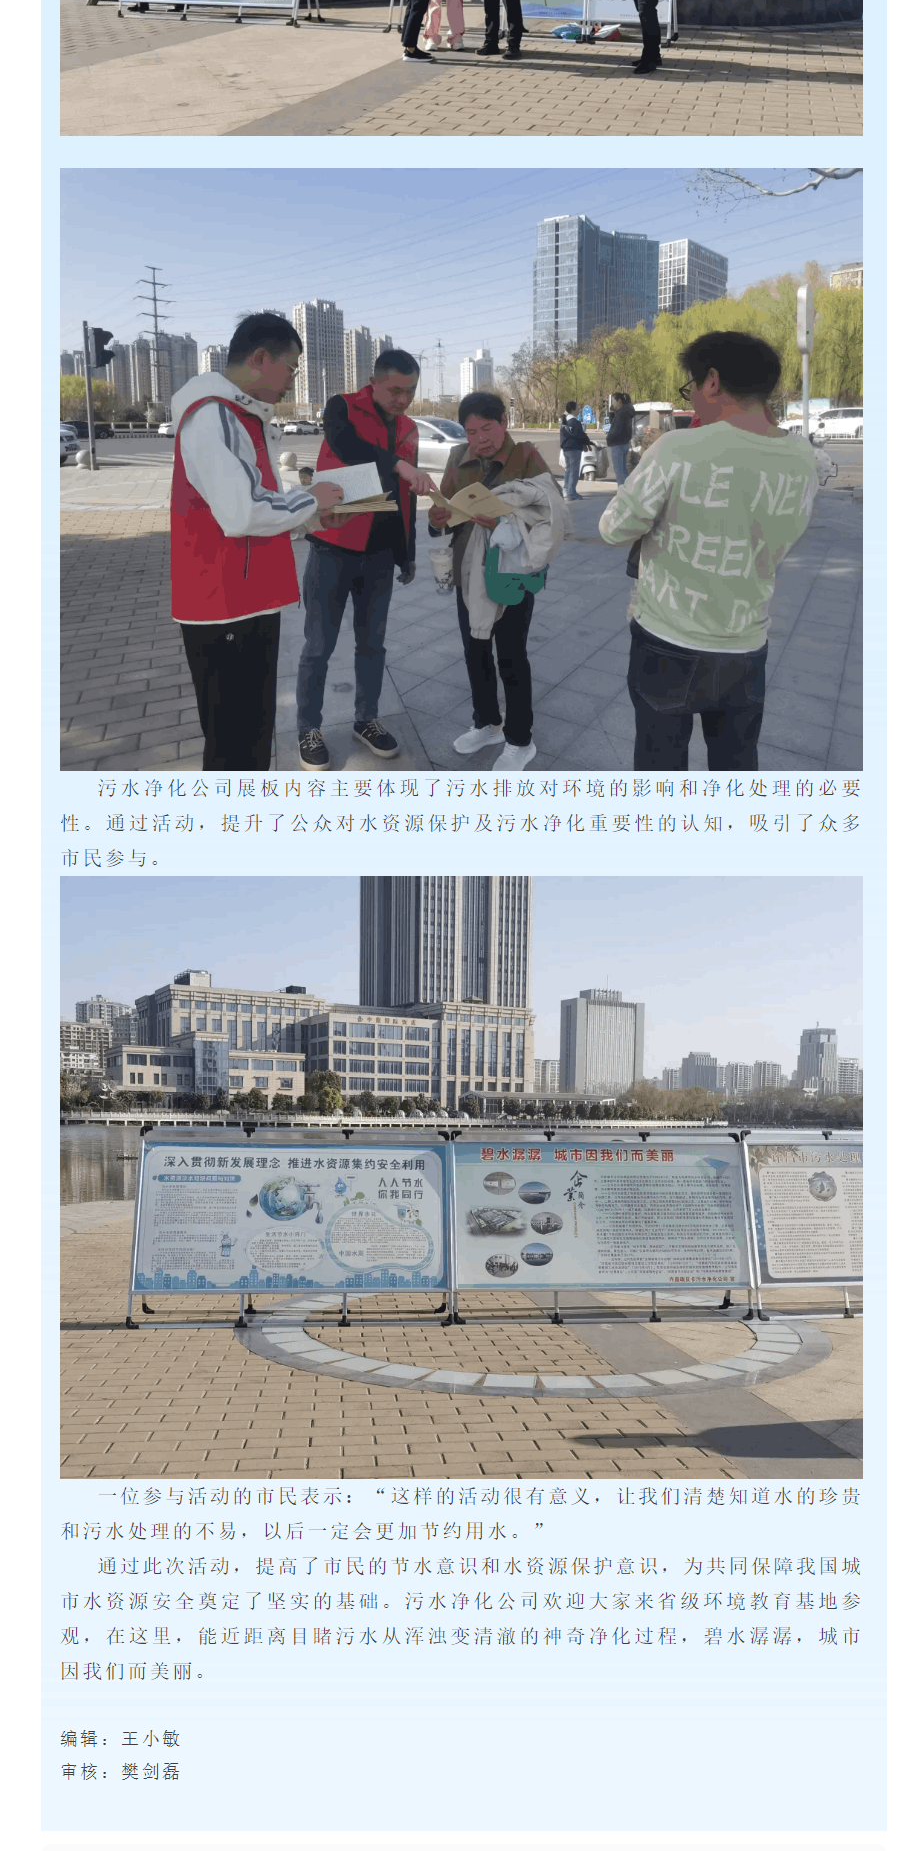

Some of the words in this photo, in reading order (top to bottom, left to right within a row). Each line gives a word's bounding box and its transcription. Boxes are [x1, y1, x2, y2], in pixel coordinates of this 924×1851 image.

[480, 1147, 542, 1161] 碧水潺潺
[554, 1148, 674, 1162] 城市因我们而美丽
[163, 1155, 281, 1170] 深入贯彻新发展理念
[287, 1156, 426, 1171] 推进水资源集约安全利用
[378, 1177, 424, 1188] 人人节水
[378, 1189, 424, 1200] 你我同行
